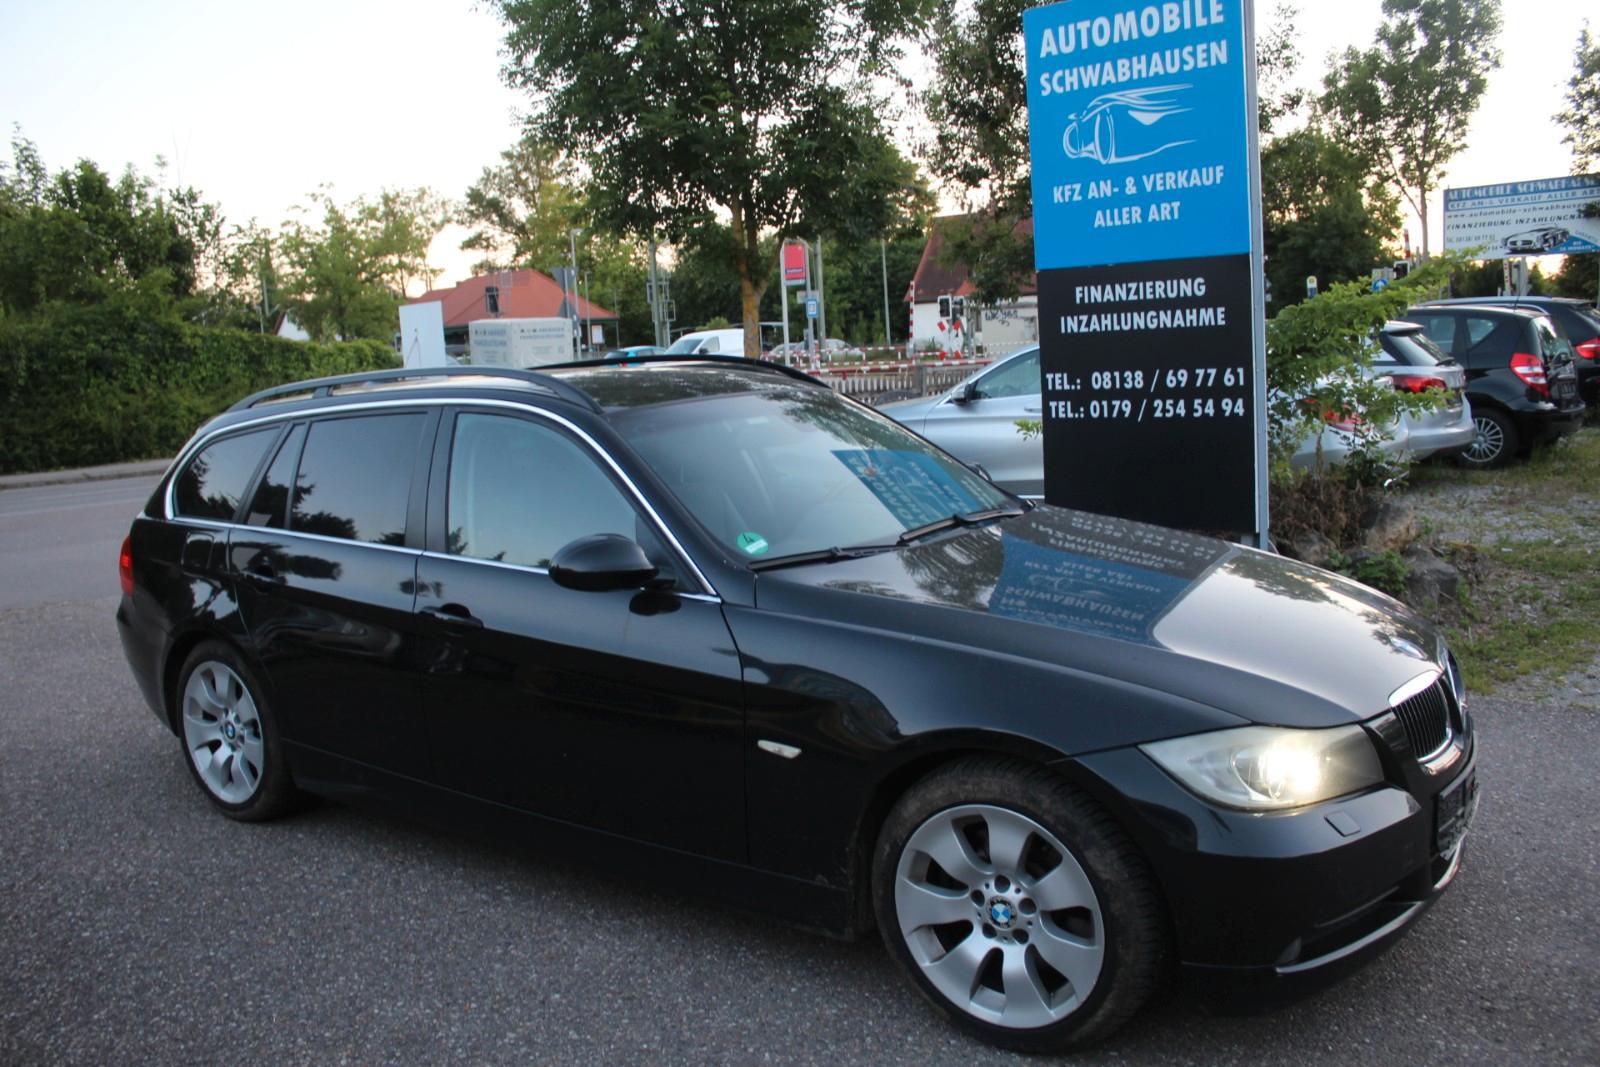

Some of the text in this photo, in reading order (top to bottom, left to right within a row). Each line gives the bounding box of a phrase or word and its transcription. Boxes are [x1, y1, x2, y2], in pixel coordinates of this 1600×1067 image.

[1040, 0, 1224, 58] AUTOMOBILE
[1039, 39, 1228, 96] SCHWABHAUSEN
[1053, 165, 1224, 203] KFZ AN- & VERKAUF
[1094, 201, 1180, 228] ALLER ART
[1075, 277, 1205, 304] FINANZIERUNG
[1060, 307, 1226, 334] INZAHLUNGNAHME
[1046, 367, 1245, 393] TEL.: 08138 / 69 77 61
[1050, 398, 1245, 423] TEL.: 0179 / 254 54 94
